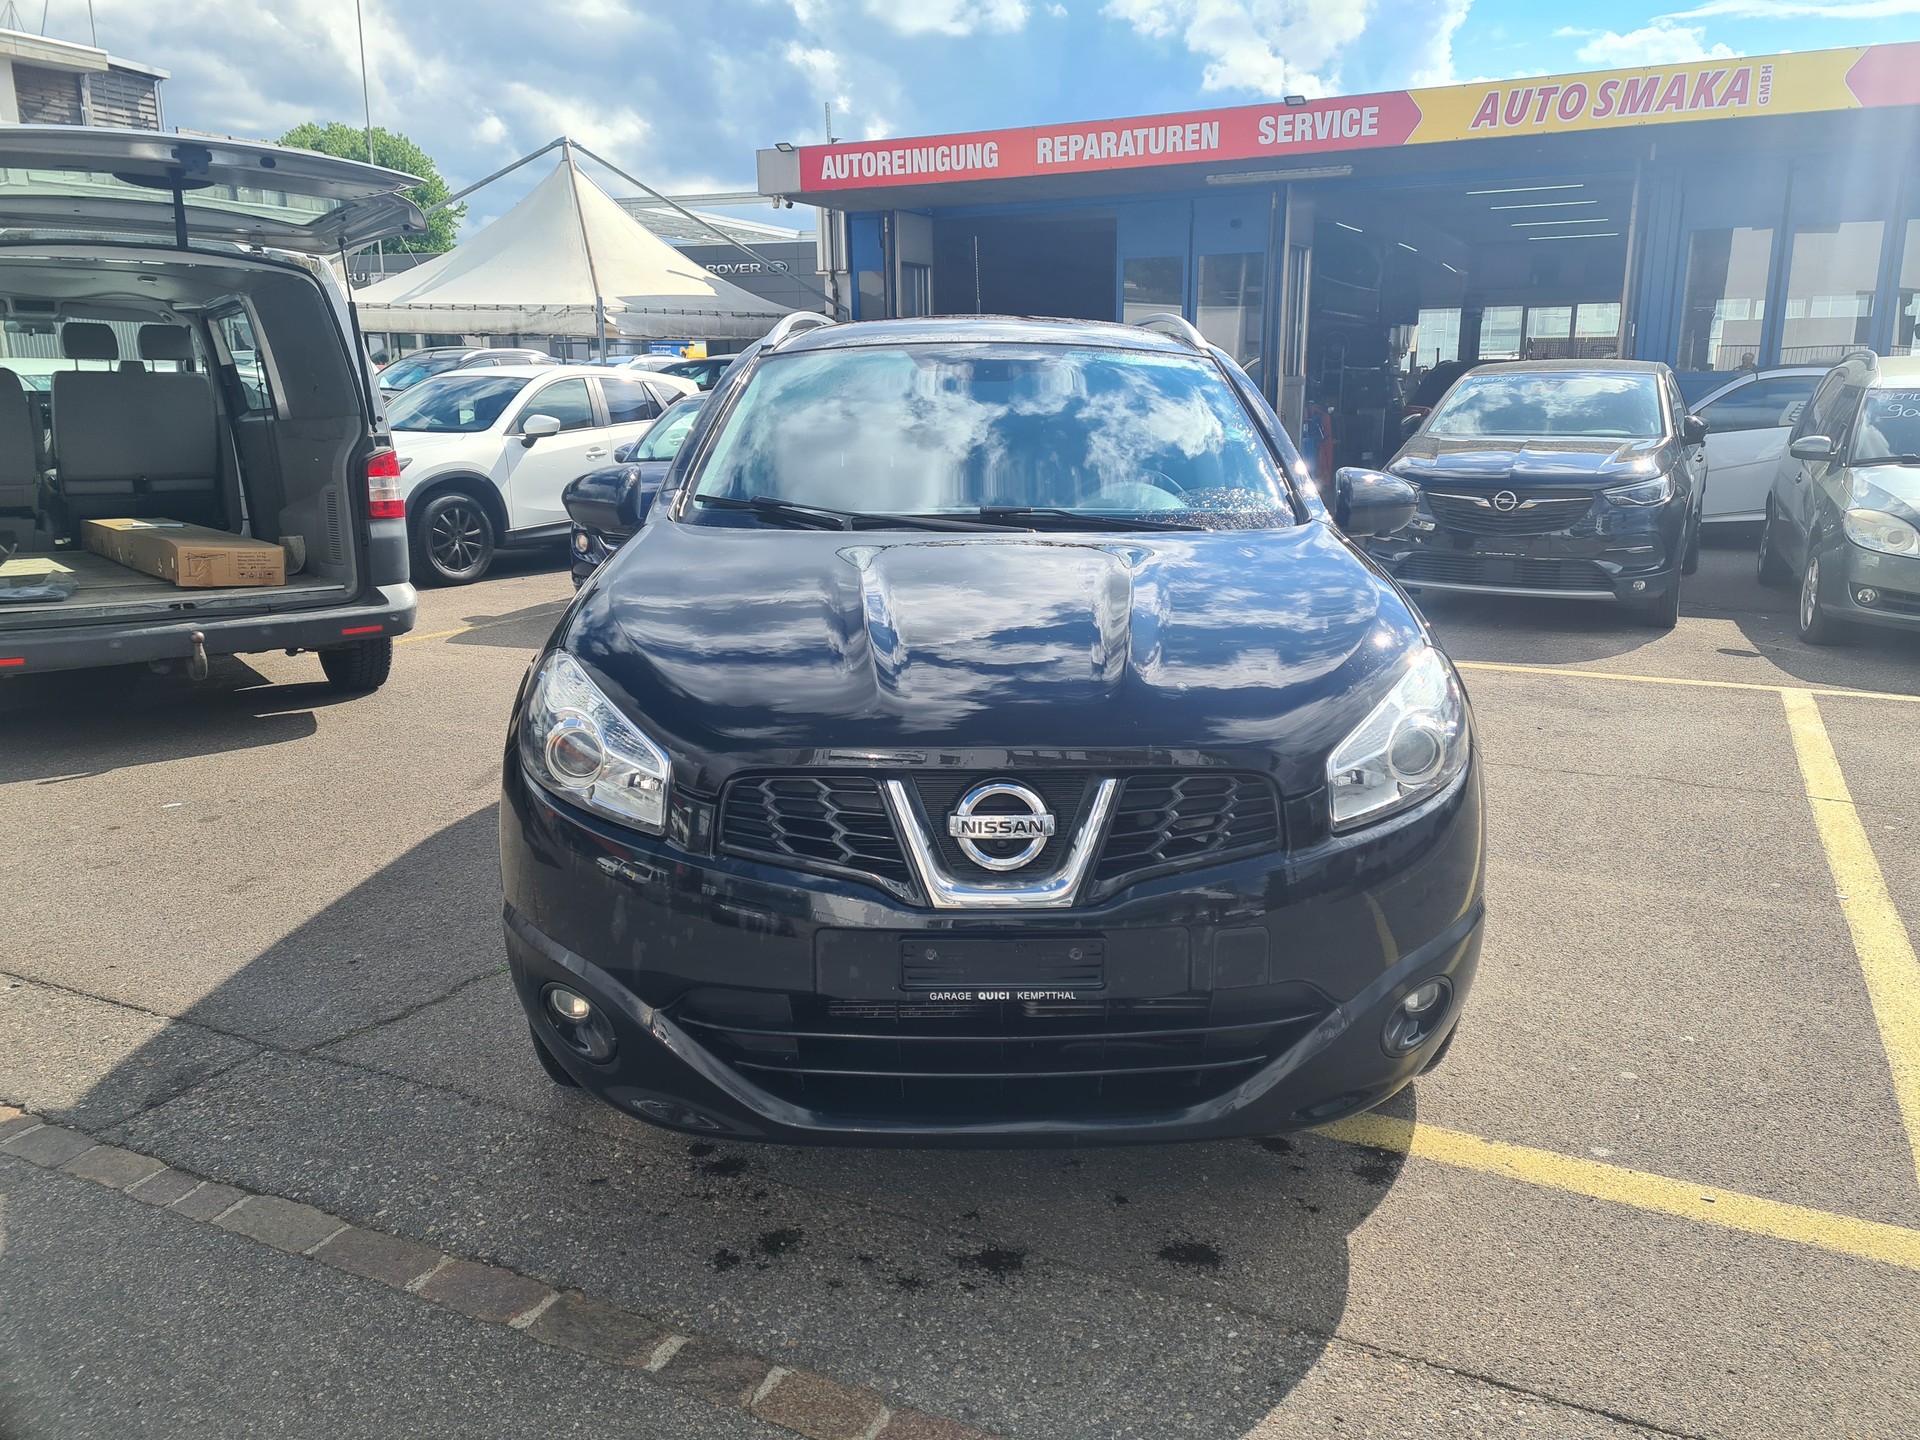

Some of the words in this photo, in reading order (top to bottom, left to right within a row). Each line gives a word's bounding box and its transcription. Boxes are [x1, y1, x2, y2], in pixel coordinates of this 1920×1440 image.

[1468, 82, 1588, 131] AUTO
[1592, 66, 1752, 119] SMAKA
[1758, 64, 1774, 106] GMBH
[821, 141, 999, 180] AUTOREINIGUNG
[1036, 121, 1220, 164] REPARATUREN
[1258, 105, 1379, 145] SERVICE
[705, 263, 761, 274] ROVER
[1880, 404, 1920, 419] 90
[961, 820, 1044, 834] NISSAN
[929, 992, 972, 1001] GARAGE
[978, 992, 1010, 1001] QUICI
[1017, 992, 1076, 1000] KEMPTTHAL
